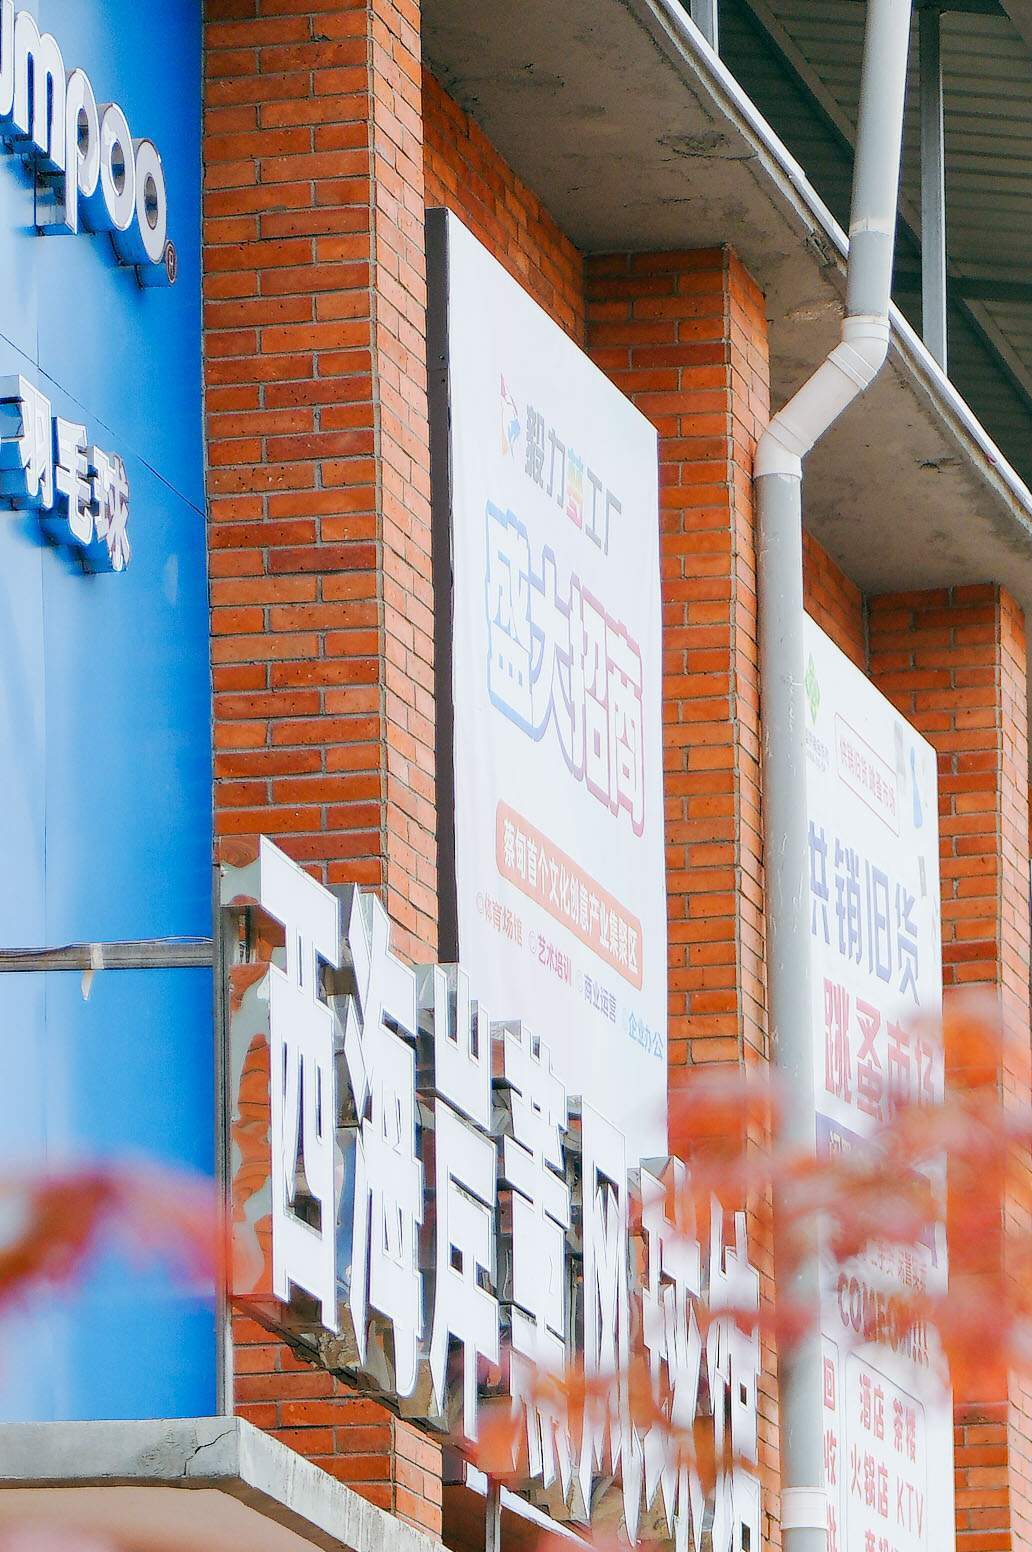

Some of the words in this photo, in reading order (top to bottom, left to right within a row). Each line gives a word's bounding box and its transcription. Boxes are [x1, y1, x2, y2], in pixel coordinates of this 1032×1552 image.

[18, 373, 132, 572] 羽毛球
[485, 498, 646, 838] 盛大招商
[502, 818, 639, 976] 蔡甸首个文化创意产业集聚区
[538, 934, 572, 992] 艺术培训
[584, 974, 617, 1024] 商业运营
[628, 1011, 664, 1060] 企业办公
[859, 1372, 885, 1438] 酒店
[850, 1441, 889, 1524] 火锅店
[896, 1473, 924, 1540] KTV
